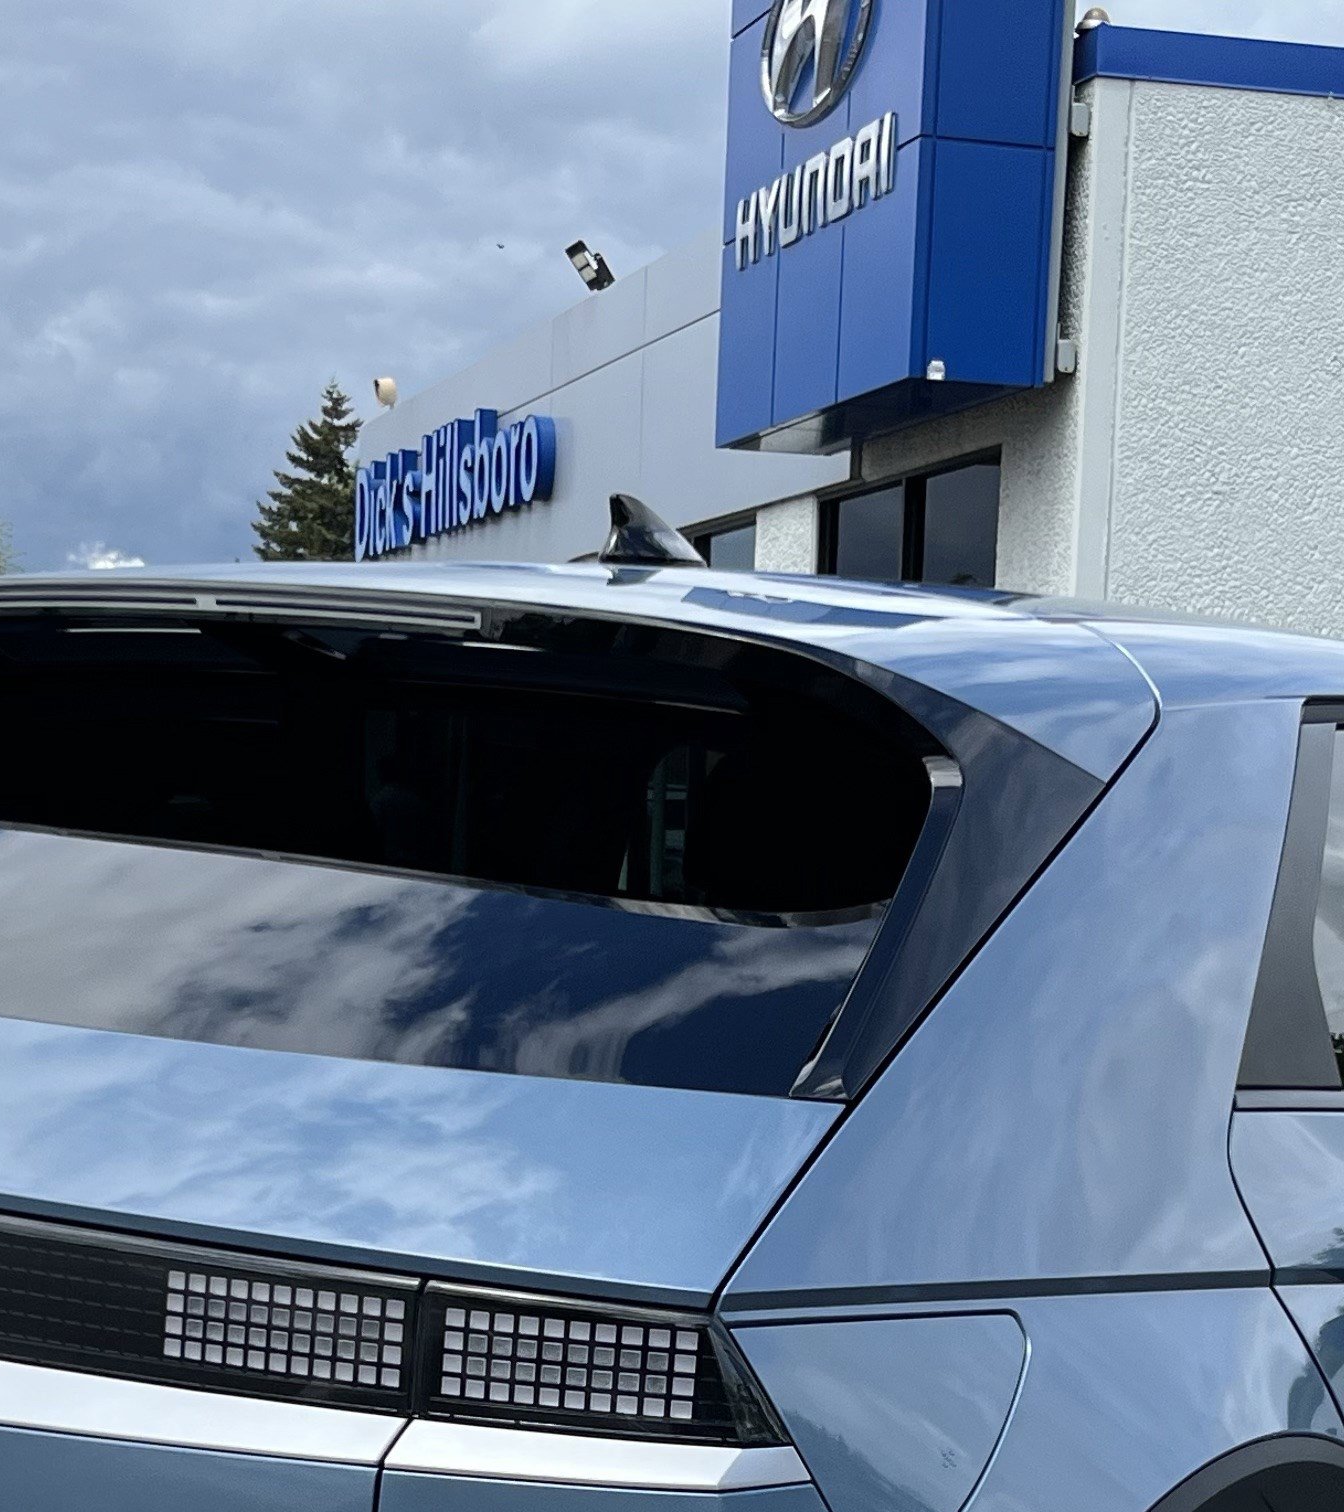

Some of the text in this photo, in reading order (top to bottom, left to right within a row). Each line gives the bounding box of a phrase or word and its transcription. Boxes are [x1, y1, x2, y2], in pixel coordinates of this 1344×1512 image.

[736, 112, 897, 271] HYUNDAI
[355, 409, 542, 563] Dick's Hillsboro
